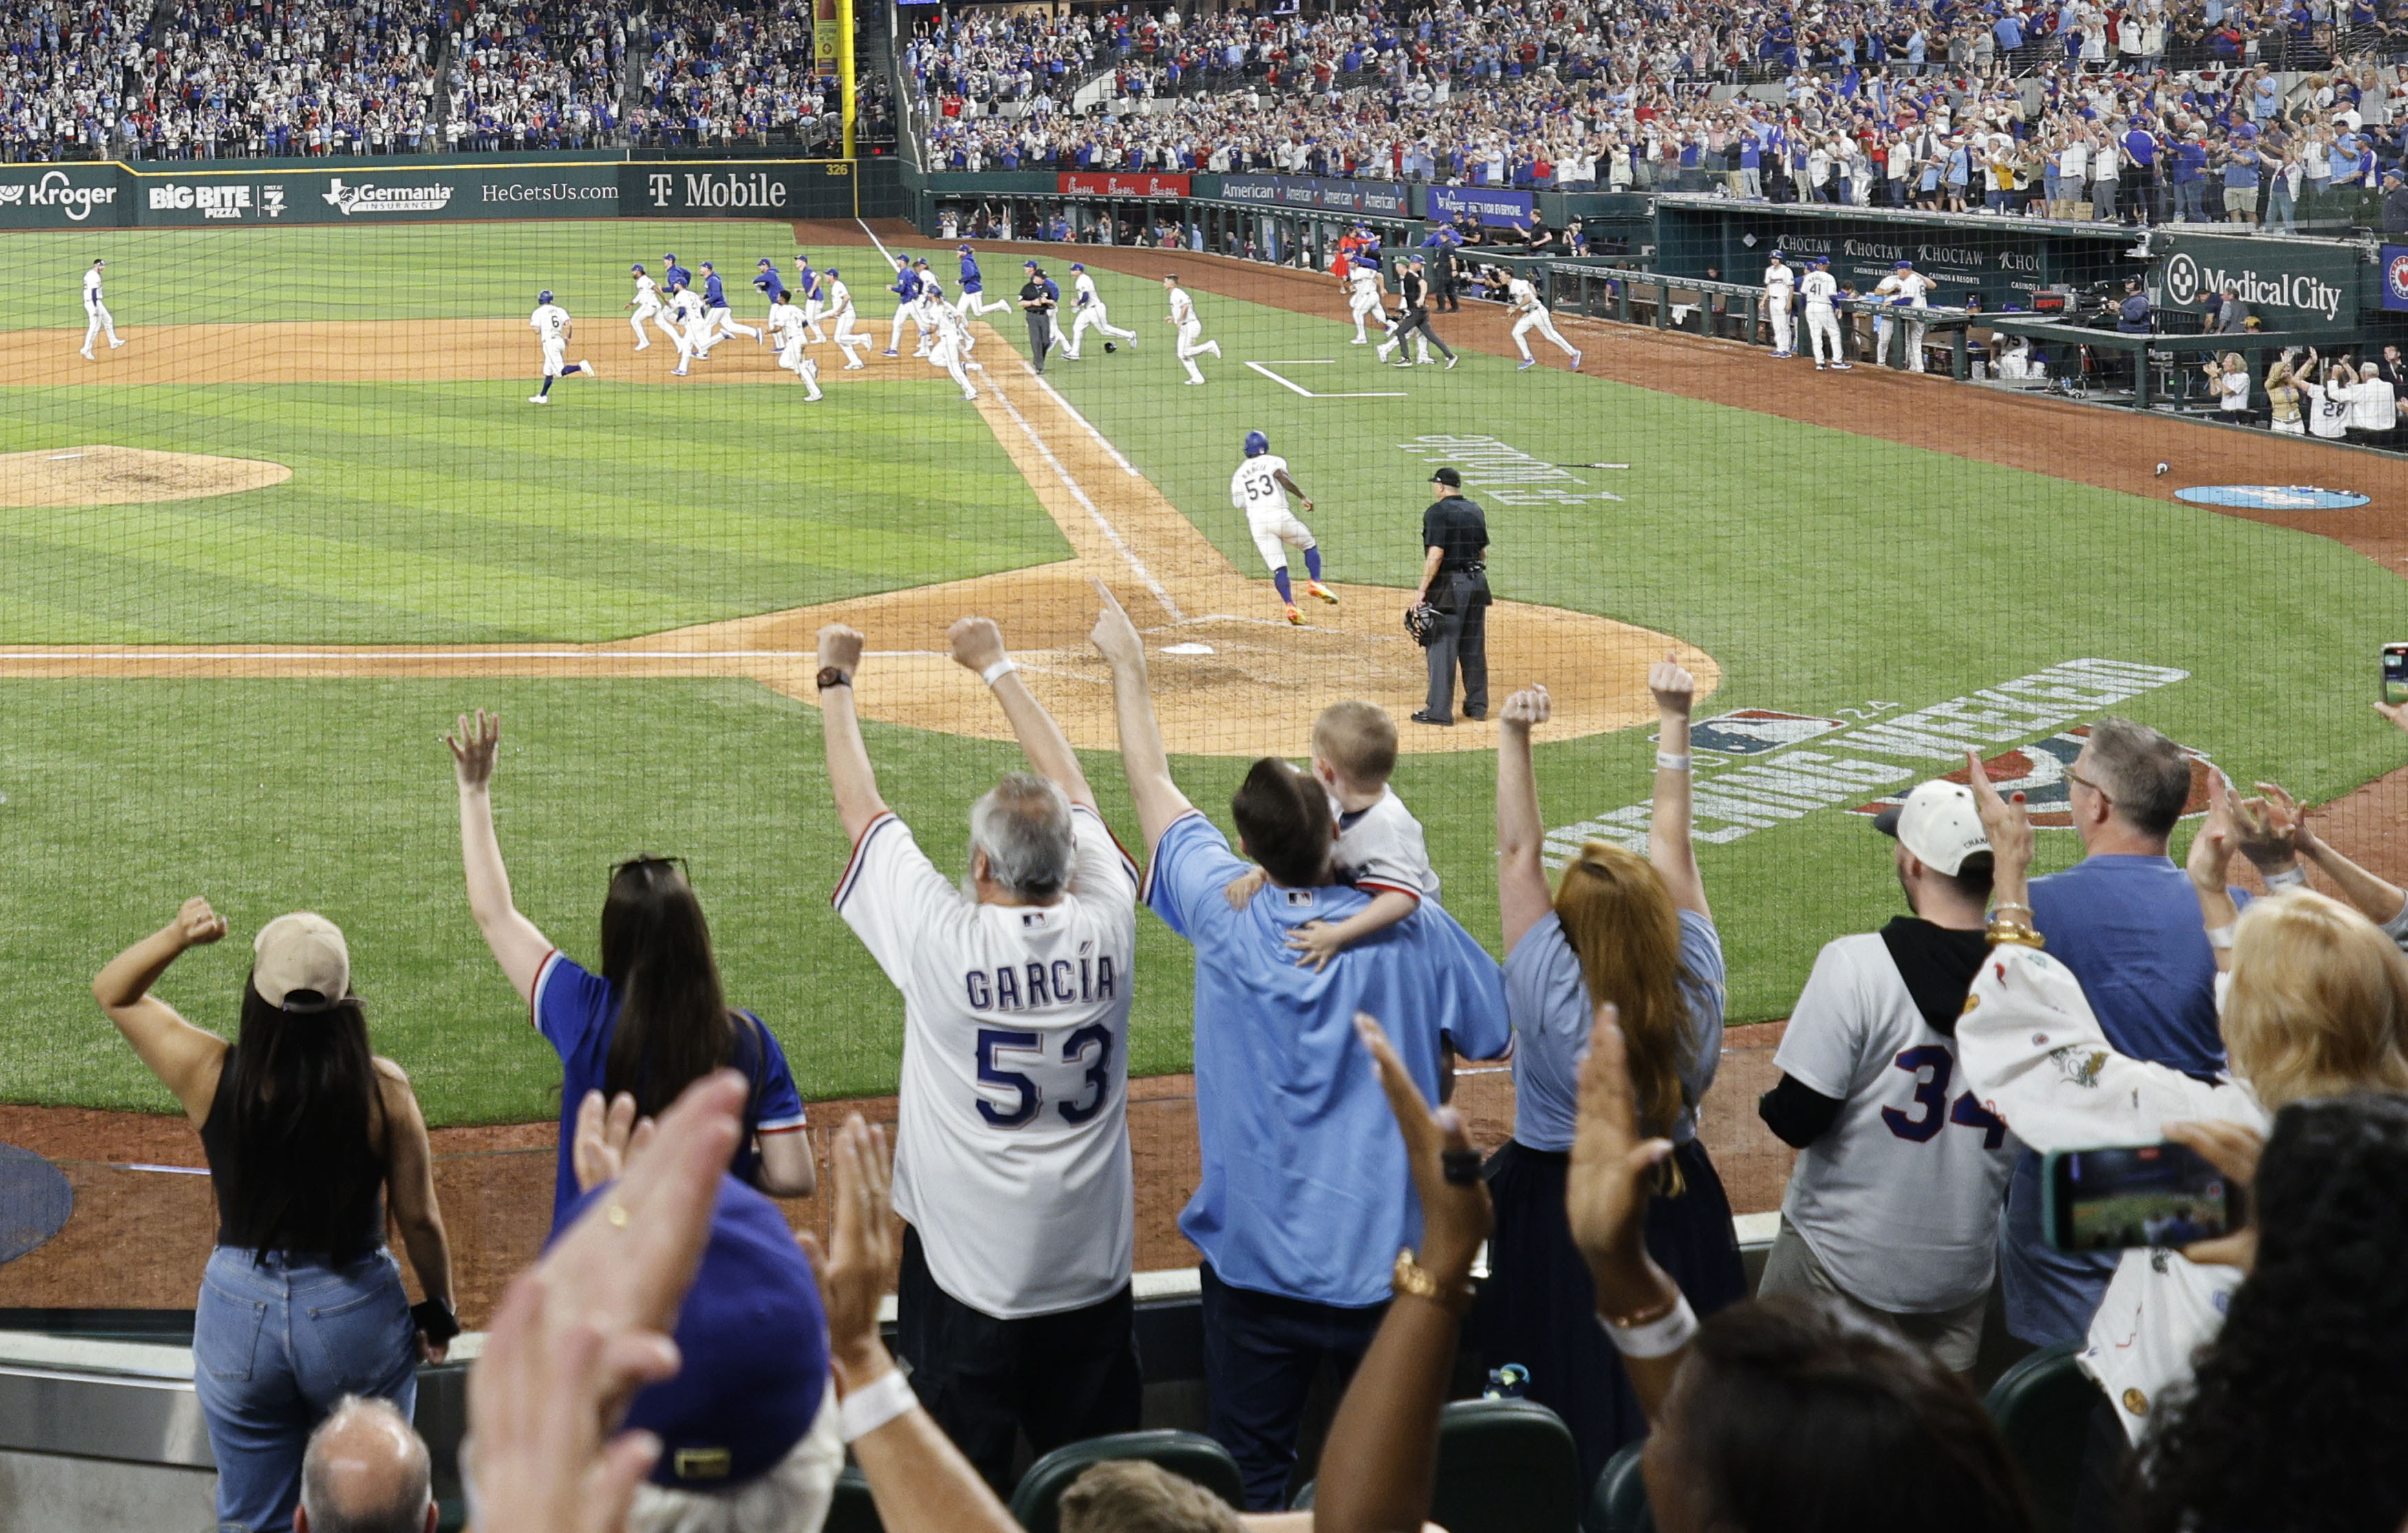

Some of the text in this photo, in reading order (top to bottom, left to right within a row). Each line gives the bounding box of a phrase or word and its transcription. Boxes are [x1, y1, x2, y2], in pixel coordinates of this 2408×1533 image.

[826, 164, 848, 176] 326
[29, 171, 118, 221] Kroger
[359, 182, 451, 201] Germania
[482, 182, 620, 202] HeGetsUs.com
[684, 172, 787, 207] Mobile
[1223, 182, 1274, 200] American
[365, 201, 435, 210] INSURANCE
[1365, 191, 1397, 210] American
[204, 207, 242, 219] PIZZA
[1781, 234, 1831, 253] CHOCTAW
[1849, 239, 1903, 259] CHOCTAW
[1923, 244, 1984, 266] CHOCTAW
[1928, 272, 1951, 282] CASINOS
[1957, 275, 1980, 285] RESORTS
[2010, 281, 2036, 290] CASINOS
[1809, 283, 1821, 297] 41
[2203, 267, 2290, 306] Medical
[2292, 276, 2342, 321] City
[551, 315, 559, 328] 6
[2323, 402, 2346, 418] 28
[1245, 474, 1273, 501] 53
[1820, 657, 2192, 762] WEEKEND
[965, 940, 1117, 1012] GARCÍA
[975, 1023, 1115, 1131] 53
